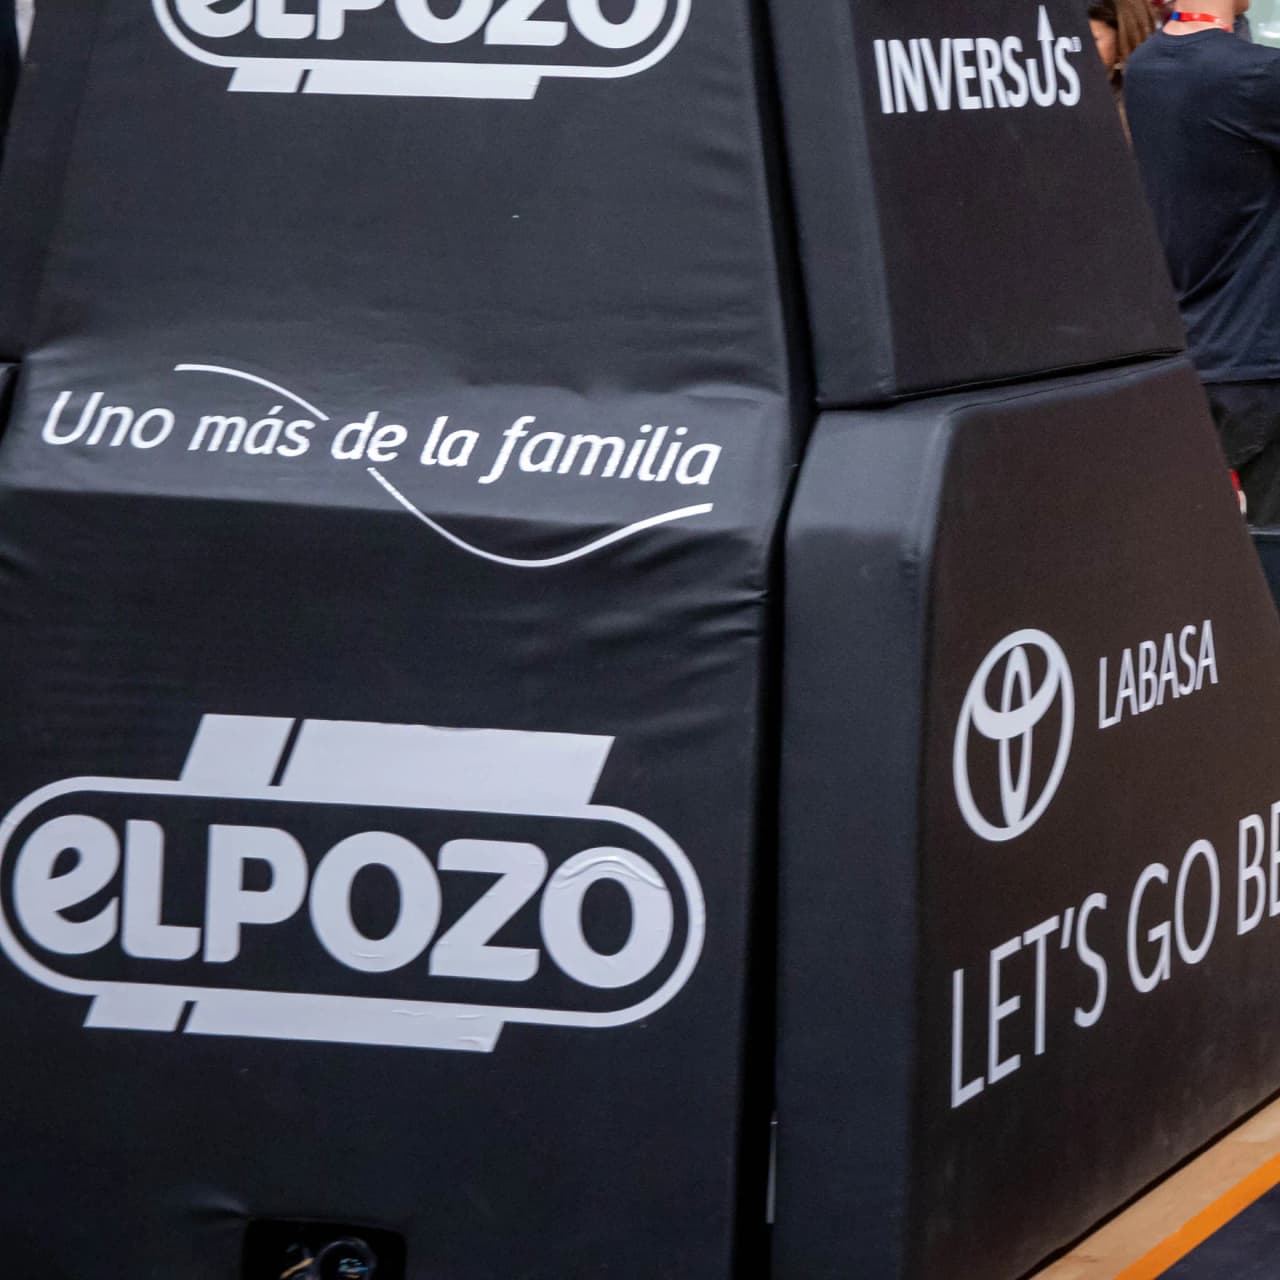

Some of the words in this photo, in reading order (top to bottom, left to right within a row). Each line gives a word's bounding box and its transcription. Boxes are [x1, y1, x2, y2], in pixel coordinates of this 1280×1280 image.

[42, 391, 174, 451] Uno
[188, 404, 317, 456] más
[330, 410, 408, 463] de
[420, 416, 481, 468] la
[478, 415, 724, 487] familia
[1099, 619, 1219, 730] LABASA
[951, 892, 1109, 1109] LET'S
[1127, 838, 1221, 993] GO
